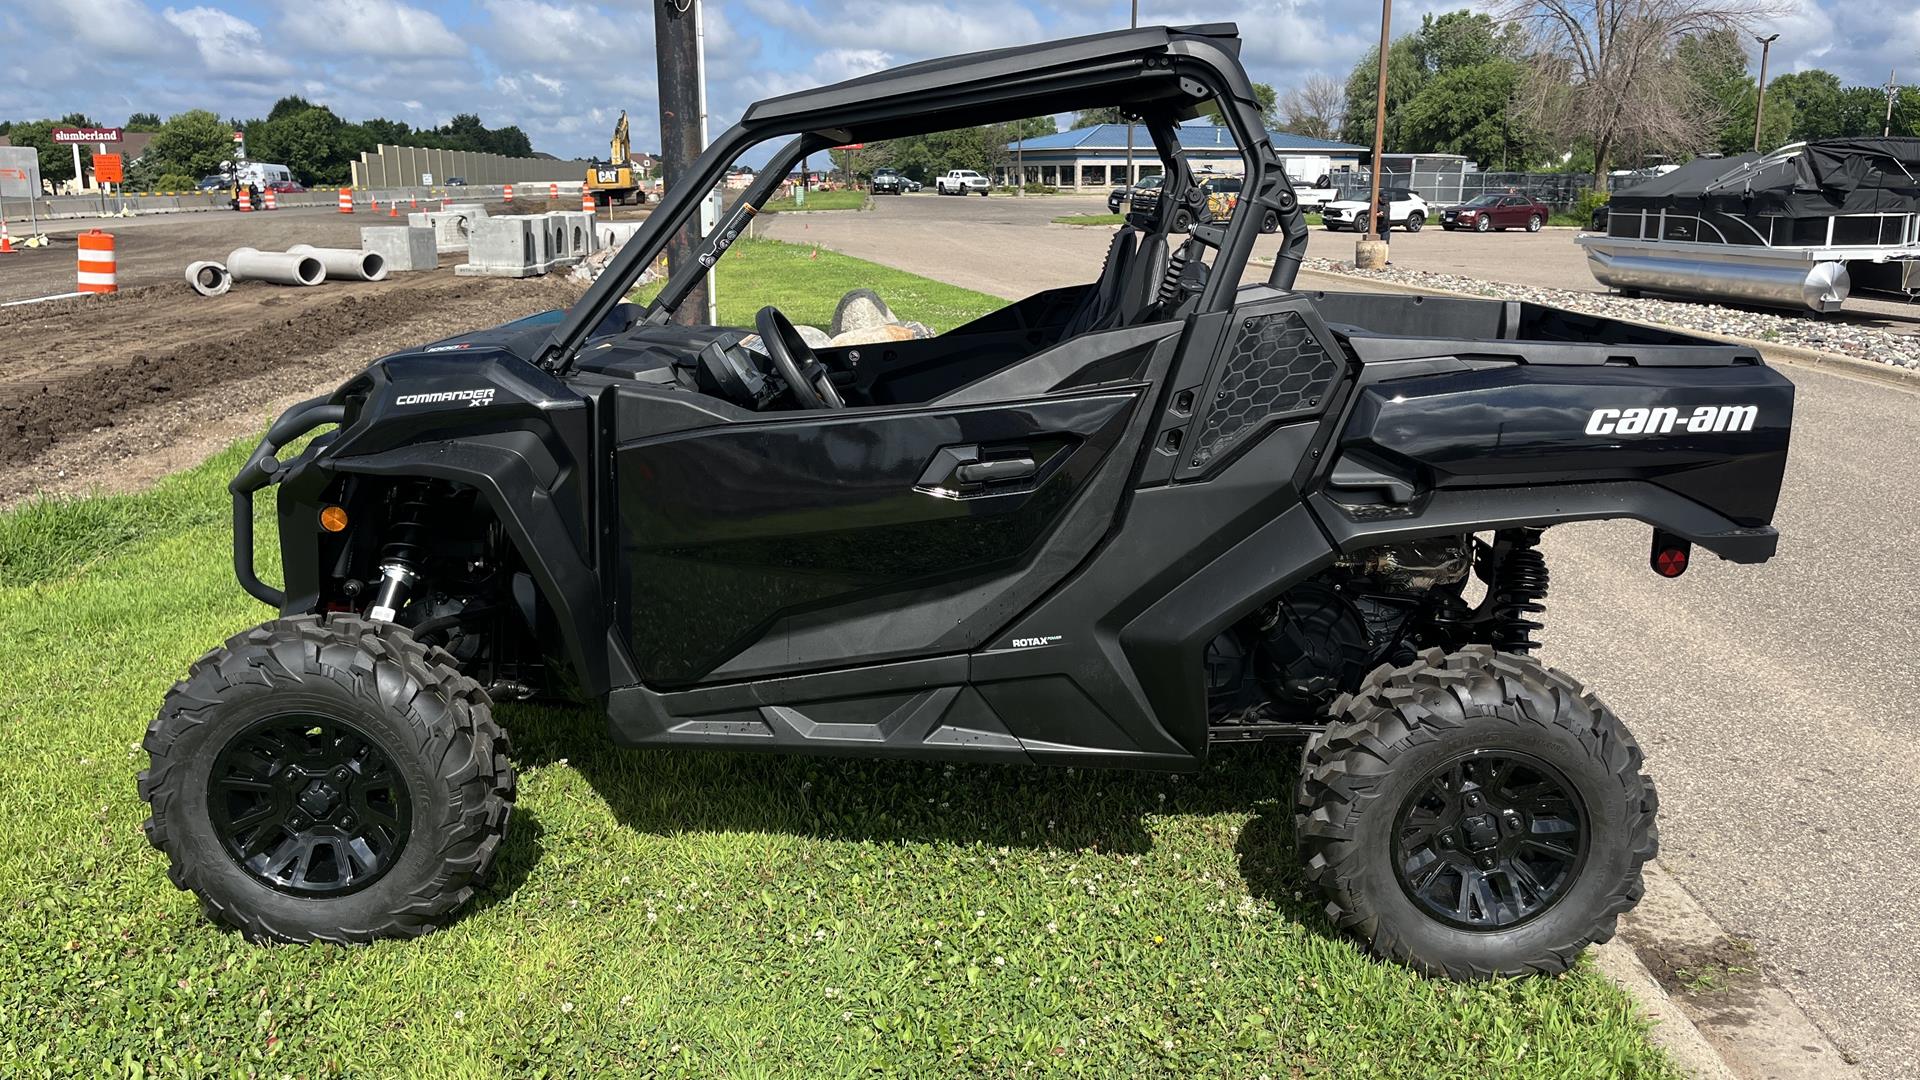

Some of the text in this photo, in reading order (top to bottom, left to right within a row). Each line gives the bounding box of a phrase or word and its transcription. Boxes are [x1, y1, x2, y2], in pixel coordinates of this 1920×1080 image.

[55, 130, 117, 141] slumberland
[598, 170, 616, 183] CAT
[396, 388, 496, 406] COMMANDER
[468, 397, 494, 408] XT
[1584, 405, 1759, 435] can-am
[1012, 636, 1048, 648] ROTAX
